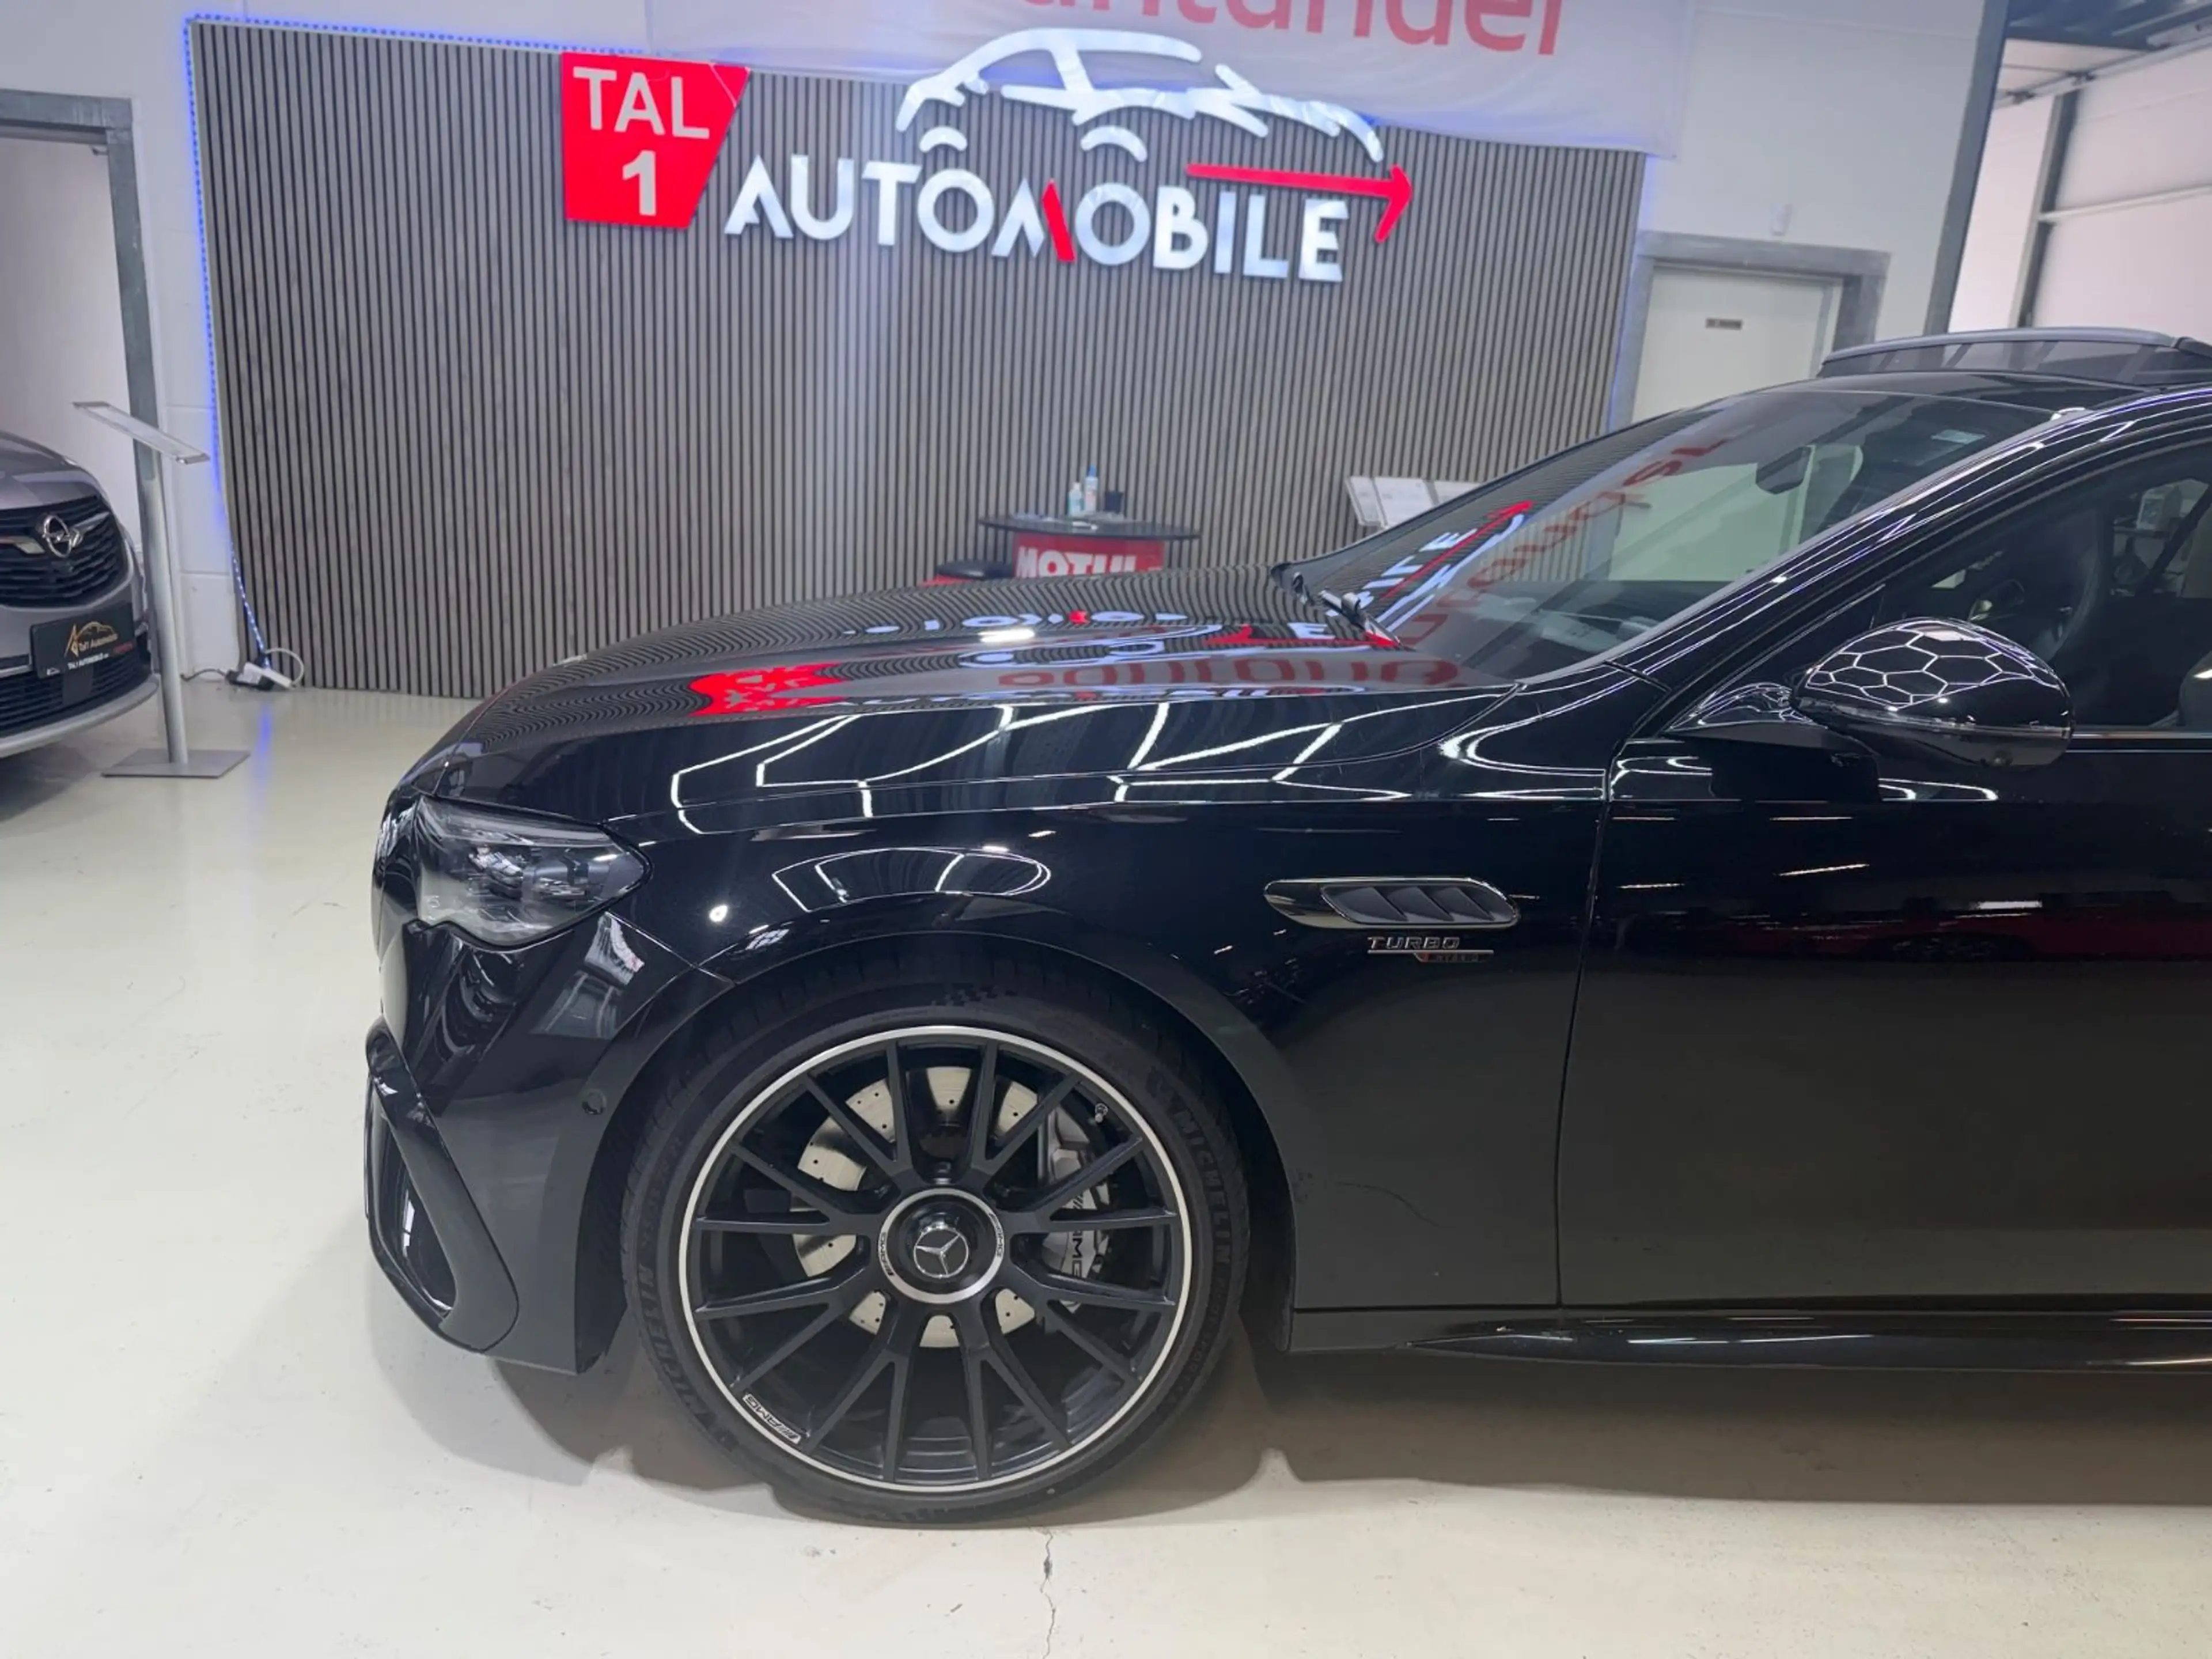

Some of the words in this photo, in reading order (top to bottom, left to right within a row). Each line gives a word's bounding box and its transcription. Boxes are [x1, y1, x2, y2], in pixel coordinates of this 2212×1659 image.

[573, 66, 710, 139] TAL
[622, 150, 656, 217] 1
[724, 154, 1349, 281] AUTOMOBILE
[1368, 937, 1460, 949] TURBO
[1173, 1108, 1232, 1264] MICHELIN
[1071, 1230, 1084, 1278] MG
